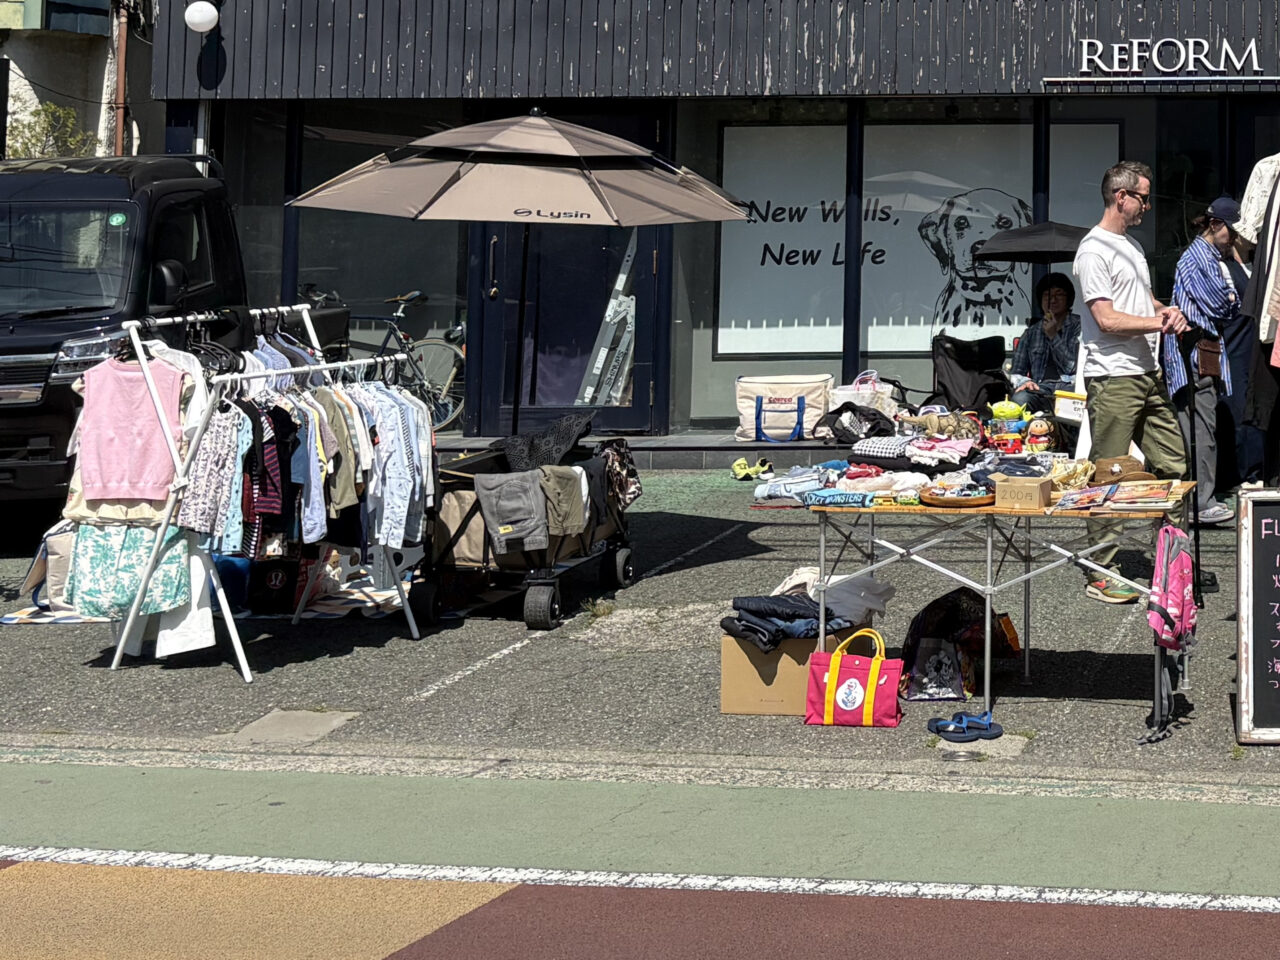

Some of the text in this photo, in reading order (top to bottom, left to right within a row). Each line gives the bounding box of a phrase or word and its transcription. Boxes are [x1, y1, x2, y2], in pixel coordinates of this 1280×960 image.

[536, 209, 591, 219] Lysin
[747, 198, 900, 226] New Wlls,
[760, 241, 887, 266] New Lfe
[1000, 490, 1033, 501] 200円
